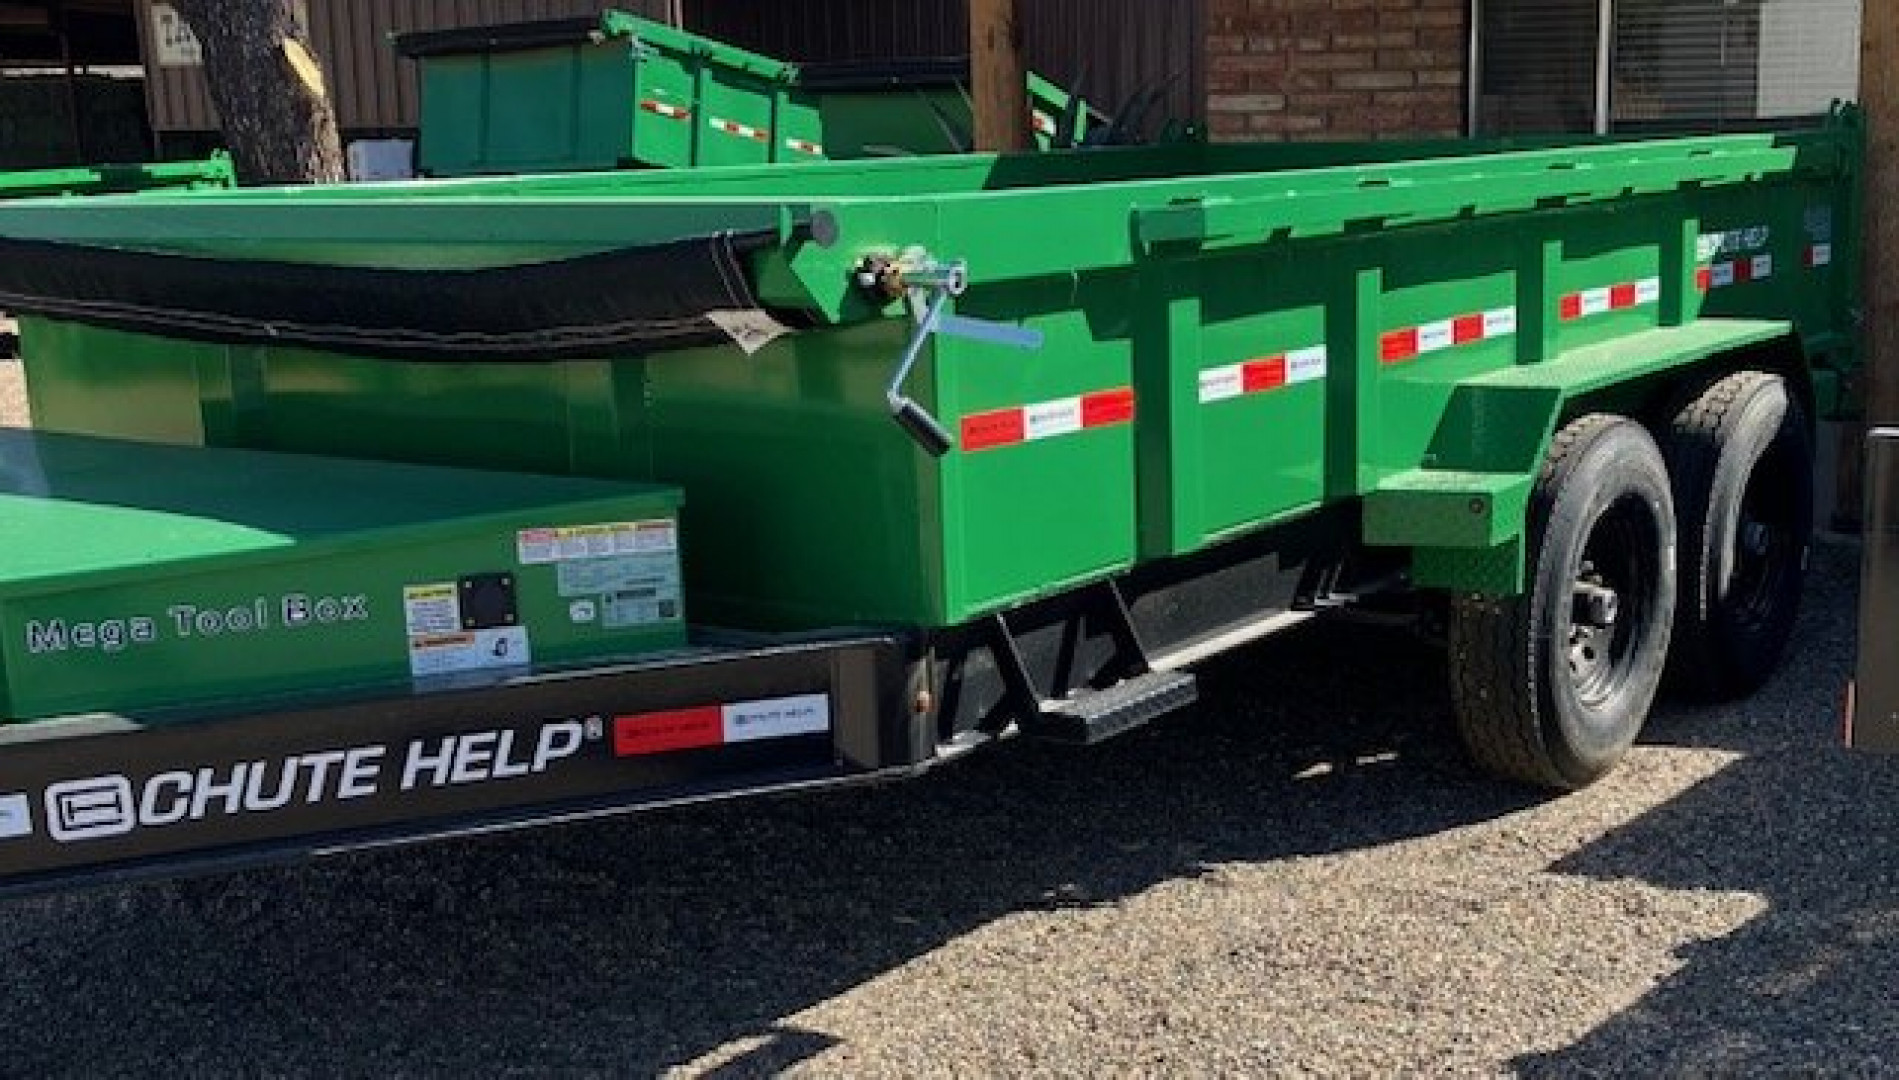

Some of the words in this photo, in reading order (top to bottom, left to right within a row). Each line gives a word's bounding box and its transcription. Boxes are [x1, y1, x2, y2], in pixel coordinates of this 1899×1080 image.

[26, 616, 156, 653] Mega
[167, 596, 269, 636] Tool
[281, 592, 369, 627] Box
[140, 745, 386, 825] CHUTE
